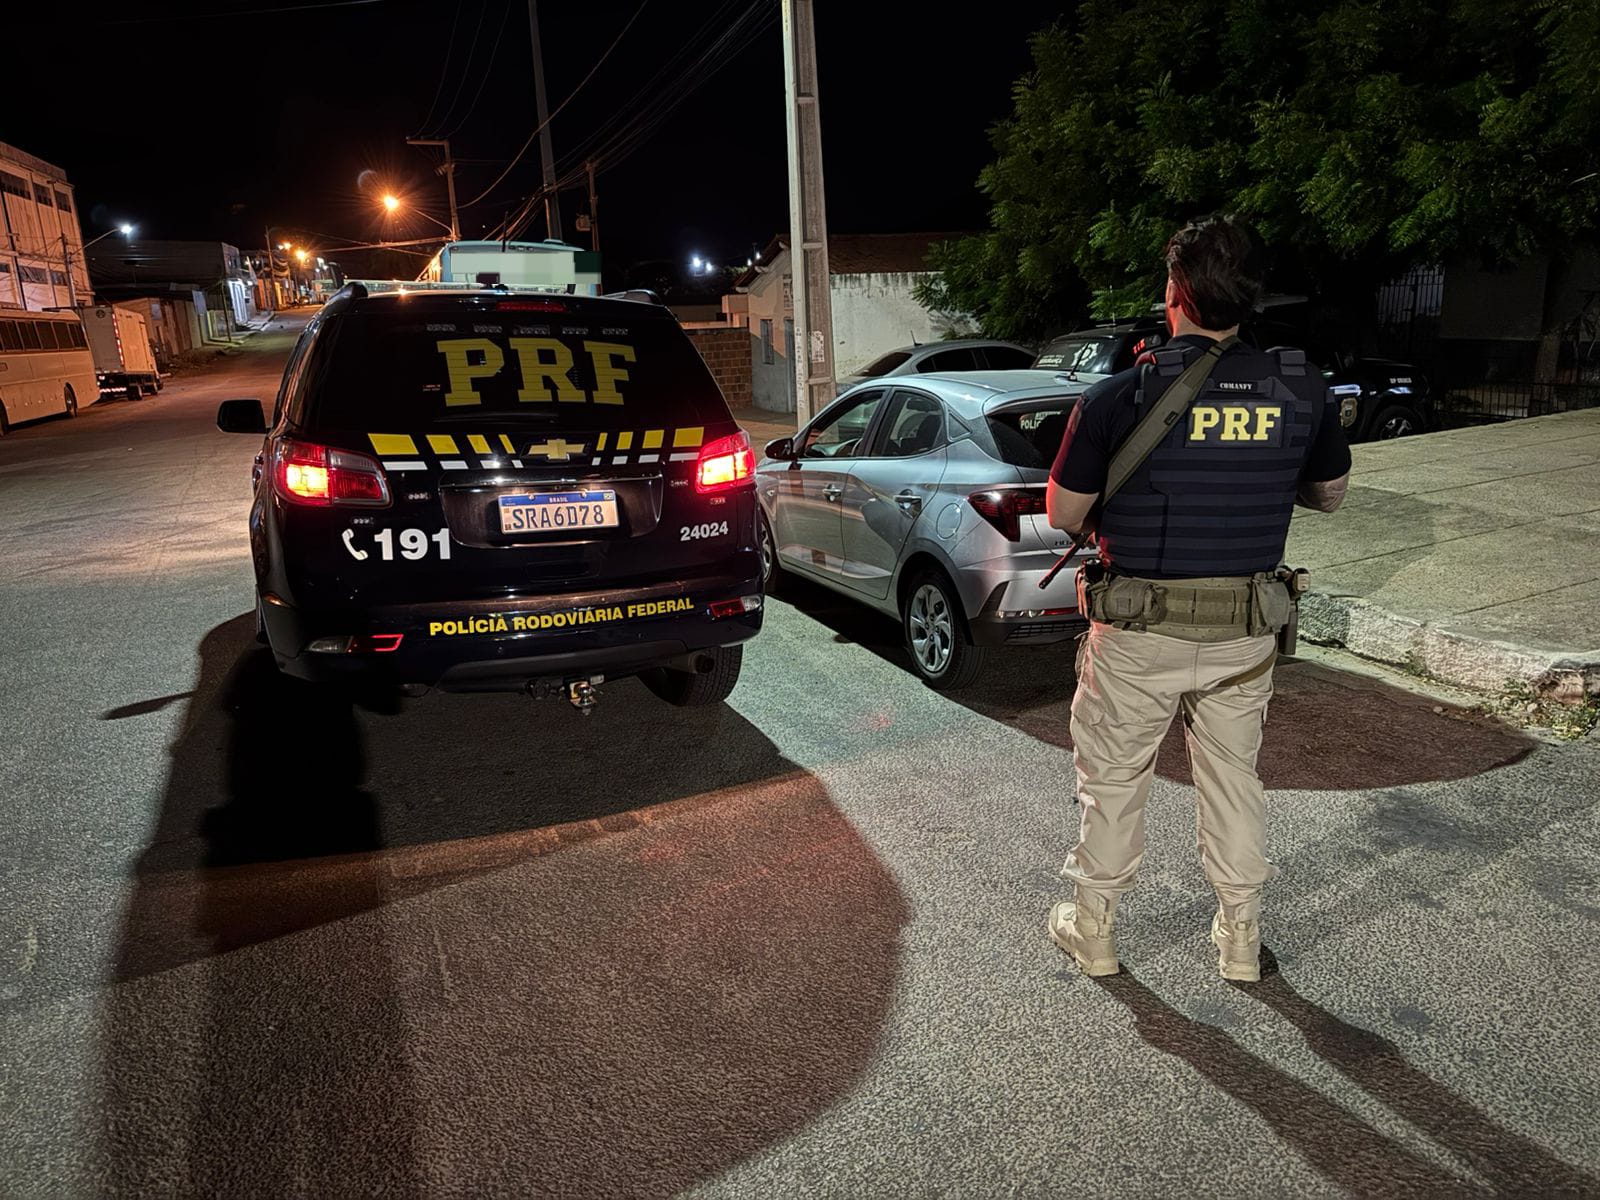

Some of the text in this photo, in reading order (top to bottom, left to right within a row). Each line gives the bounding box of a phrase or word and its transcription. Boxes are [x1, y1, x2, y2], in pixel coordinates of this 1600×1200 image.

[436, 337, 637, 407] PRF
[1190, 407, 1281, 440] PRF
[512, 504, 604, 529] SRA6D78
[680, 521, 728, 541] 24024
[374, 528, 450, 560] 191
[429, 597, 694, 636] POLÍCIA RODOVIÁRIA FEDERAL
